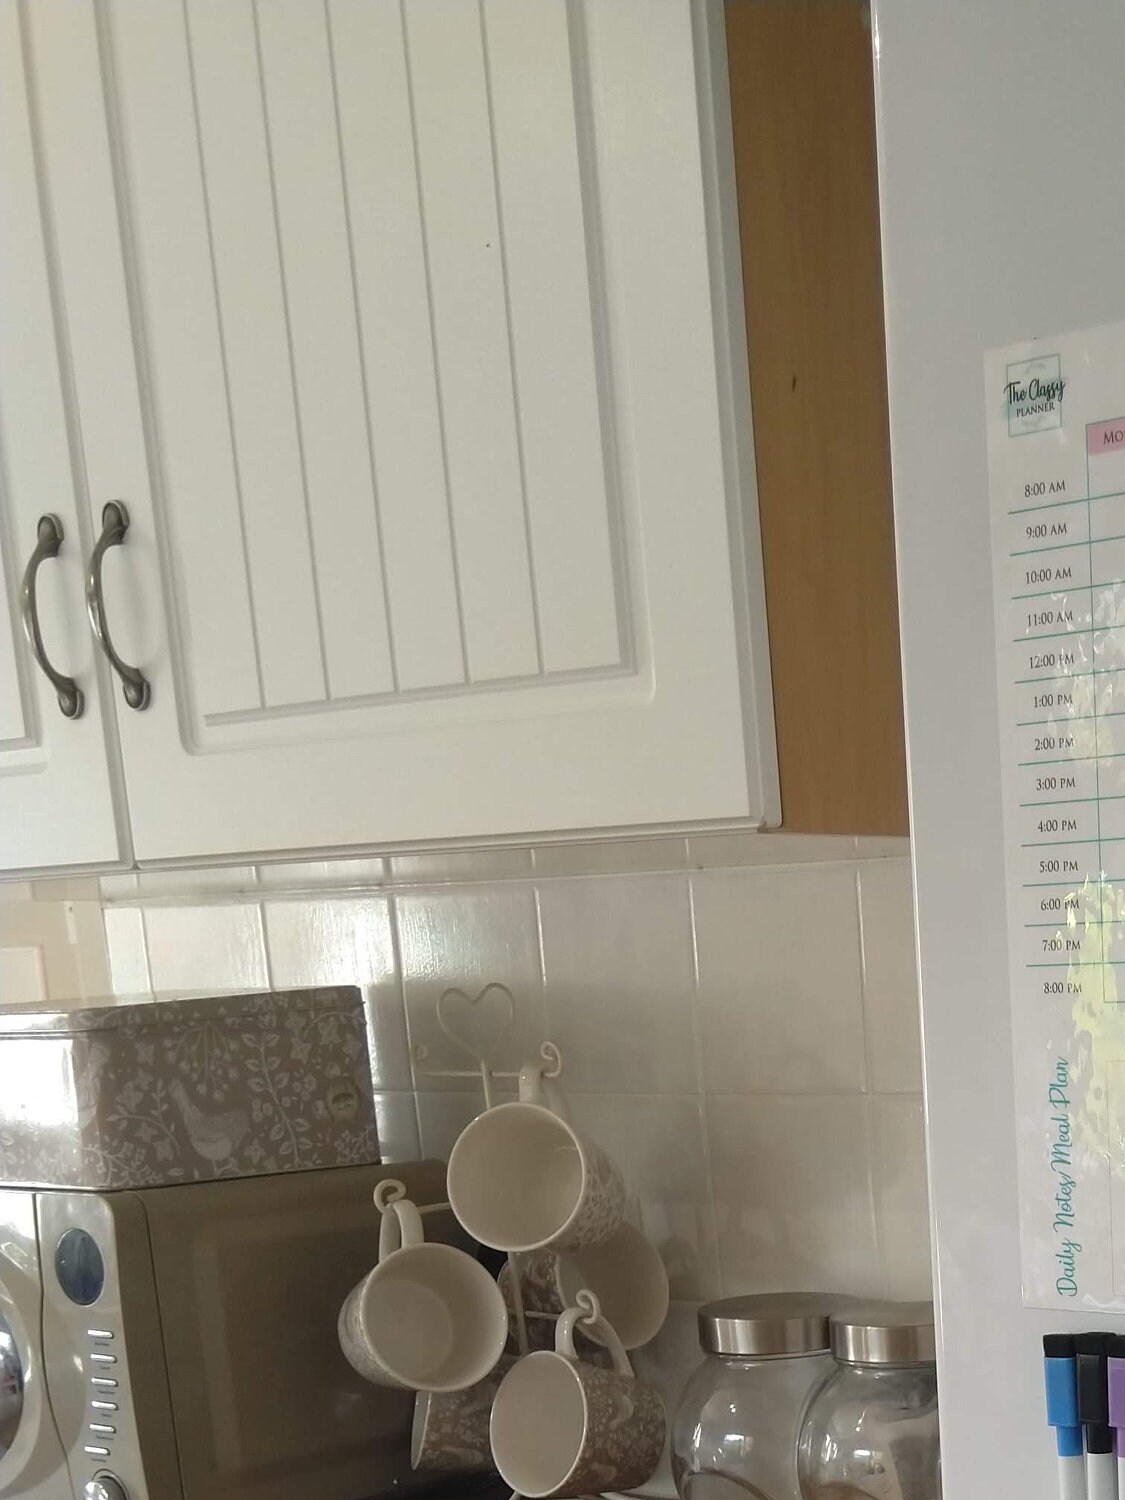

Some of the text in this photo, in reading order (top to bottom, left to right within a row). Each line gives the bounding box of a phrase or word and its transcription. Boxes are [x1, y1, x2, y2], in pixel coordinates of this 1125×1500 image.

[1003, 378, 1067, 405] The Classy
[1016, 401, 1056, 418] PLANNER
[1025, 480, 1066, 497] 8:00 AM
[1026, 523, 1067, 539] 9:00 AM
[1026, 567, 1072, 585] 10:00 AM
[1027, 609, 1073, 627] 11:00 AM
[1029, 654, 1055, 669] 12:00
[1033, 693, 1073, 708] 1:00 PM
[1034, 737, 1074, 751] 2:00 PM
[1036, 776, 1076, 791] 3:00 PM
[1037, 819, 1077, 833] 4:00 PM
[1039, 860, 1078, 873] 5:00 PM
[1040, 898, 1061, 911] 6:00
[1042, 939, 1081, 952] 7:00 PM
[1043, 982, 1082, 994] 8:00 PM
[1048, 1056, 1070, 1109] Plan
[1056, 1237, 1082, 1297] Daily
